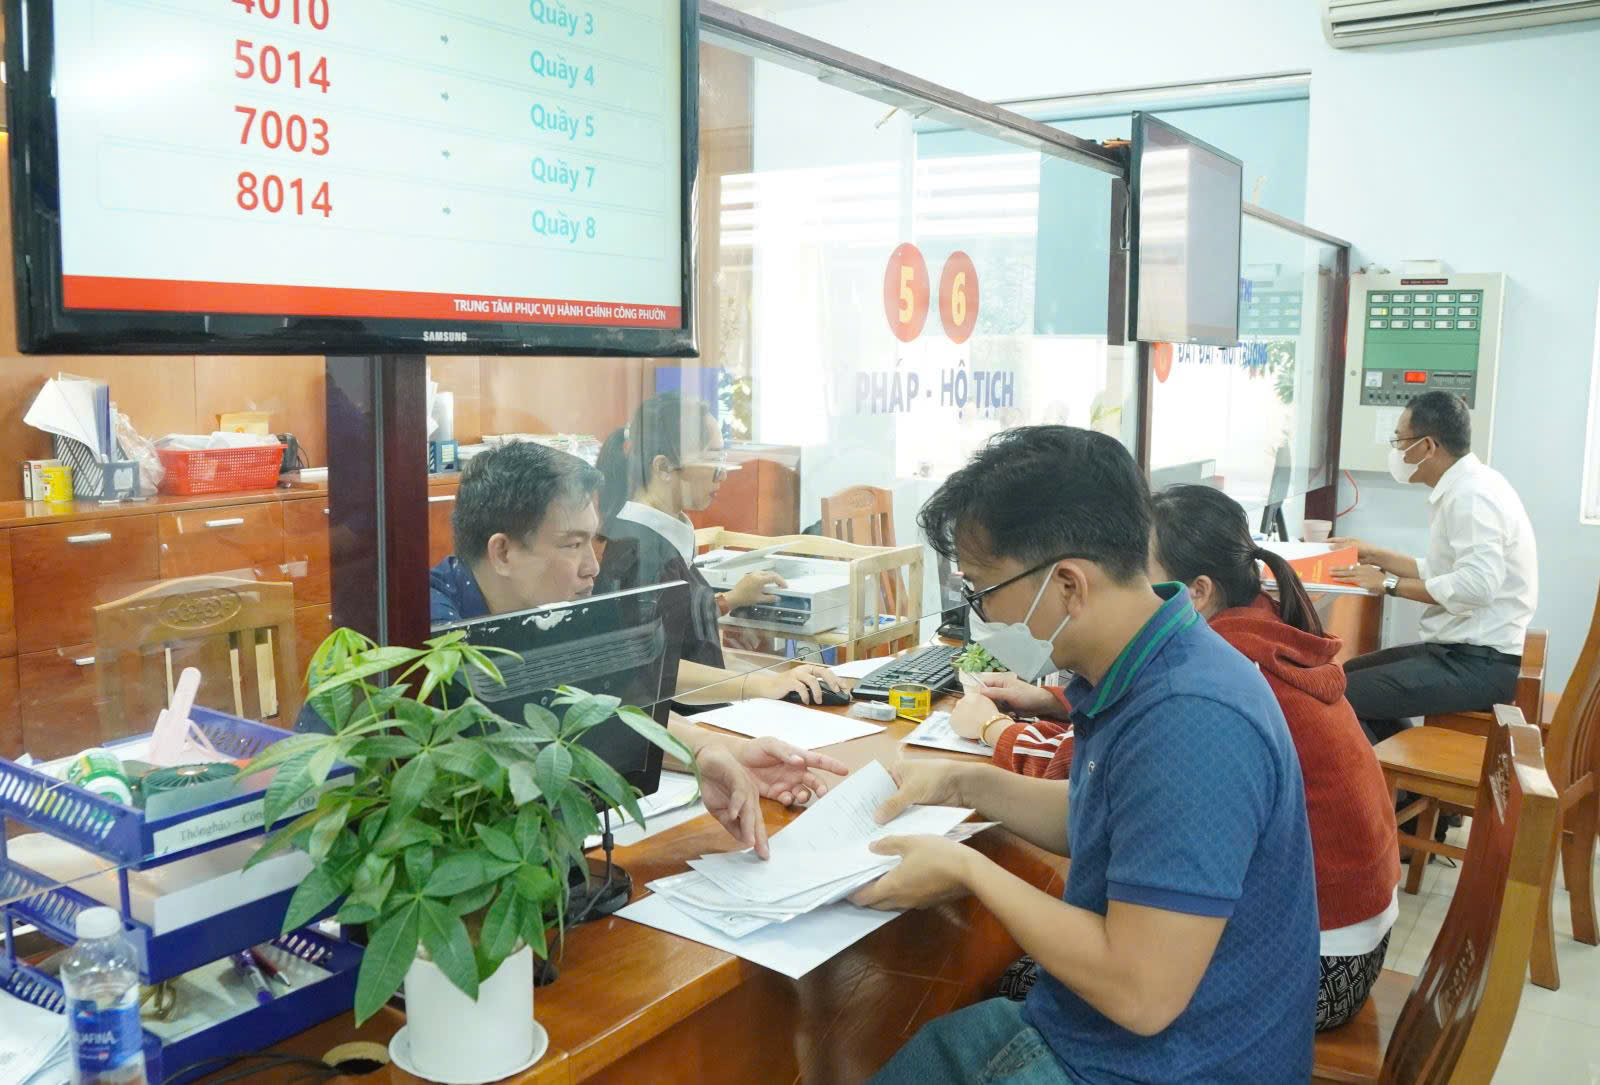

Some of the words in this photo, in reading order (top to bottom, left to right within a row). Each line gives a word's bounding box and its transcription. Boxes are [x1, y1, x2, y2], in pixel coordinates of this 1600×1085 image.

[584, 12, 593, 35] 3
[235, 39, 331, 94] 5014
[530, 50, 578, 89] Quầy
[584, 65, 595, 87] 4
[234, 105, 330, 156] 7003
[530, 103, 579, 141] Quầy
[585, 114, 595, 137] 5
[530, 156, 579, 192] Quầy
[585, 165, 596, 188] 7
[236, 171, 333, 218] 8014
[531, 209, 580, 244] Quầy
[585, 216, 596, 239] 8
[453, 298, 490, 313] TRUNG
[490, 298, 513, 314] TÂM
[515, 301, 541, 316] PHỤC
[542, 303, 555, 318] VỤ
[557, 302, 584, 317] HÀNH
[584, 304, 612, 319] CHÍNH
[613, 305, 637, 320] CÔNG
[898, 264, 915, 324] 5
[951, 271, 967, 327] 6
[422, 331, 468, 342] SAMSUNG
[855, 357, 920, 415] PHÁP
[940, 359, 968, 420] HỘ
[973, 370, 1015, 420] TỊCH
